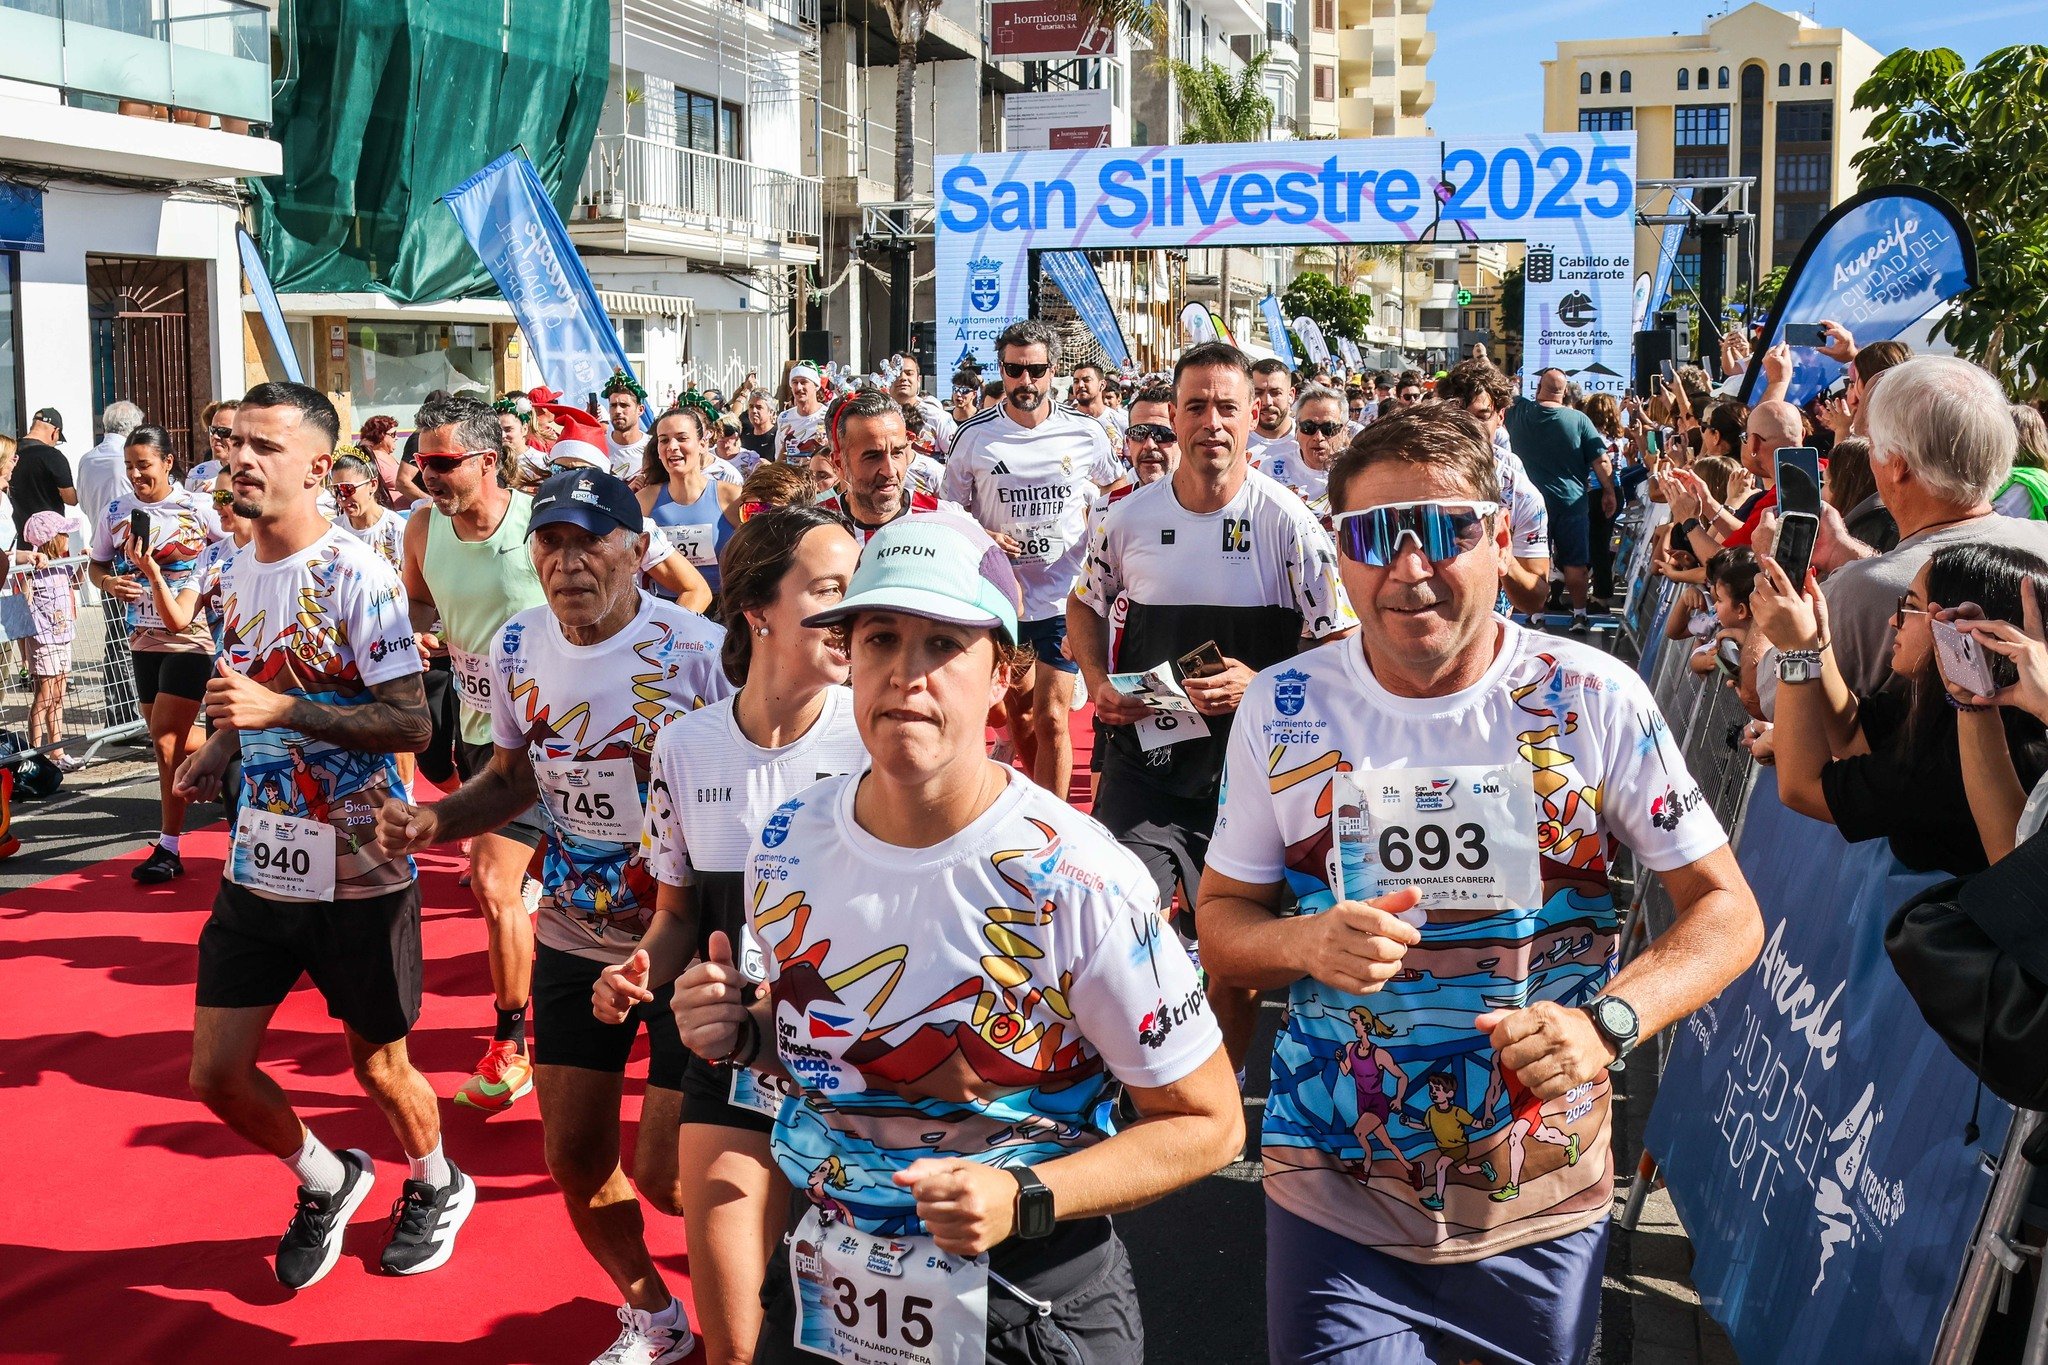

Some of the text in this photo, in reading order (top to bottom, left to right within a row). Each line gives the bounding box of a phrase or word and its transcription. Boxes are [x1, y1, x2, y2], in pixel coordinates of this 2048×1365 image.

[1013, 12, 1077, 24] hormiconsa
[1035, 23, 1066, 31] Canarias,
[941, 145, 1632, 234] San Silvestre 2025
[1559, 256, 1630, 267] Cabildo de
[1832, 217, 1921, 291] Arrecife
[1559, 269, 1625, 280] Lanzarote
[1841, 229, 1950, 307] CIUDAD DEL
[1852, 257, 1939, 323] DEPORTE
[948, 315, 1010, 326] Ayuntamiento
[955, 326, 1008, 341] Arreci
[1541, 329, 1610, 339] Centros de Arte,
[1538, 337, 1613, 347] Cultura y Turismo
[997, 483, 1072, 503] Emirates
[1011, 501, 1064, 517] FLY BETTER
[673, 542, 699, 557] 37
[876, 545, 936, 560] KIPRUN
[673, 640, 704, 651] Arrecife
[1314, 719, 1327, 728] de
[697, 787, 732, 803] GOBIK
[1382, 786, 1394, 794] 31
[1473, 784, 1499, 794] 5 KM
[554, 789, 615, 820] 745
[346, 815, 373, 827] 2025
[1378, 822, 1490, 873] 693
[254, 842, 310, 876] 940
[1056, 858, 1104, 894] Arrecife
[1377, 875, 1496, 887] HECTOR MORALES CABRERA
[1565, 1098, 1592, 1125] 2025
[870, 1249, 895, 1261] Silvestre
[926, 1256, 936, 1268] 5
[866, 1261, 892, 1274] Arrecife
[832, 1276, 934, 1348] 315
[834, 1327, 860, 1346] LETICIA
[860, 1339, 898, 1356] FAJARDO
[899, 1350, 932, 1365] PERERA
